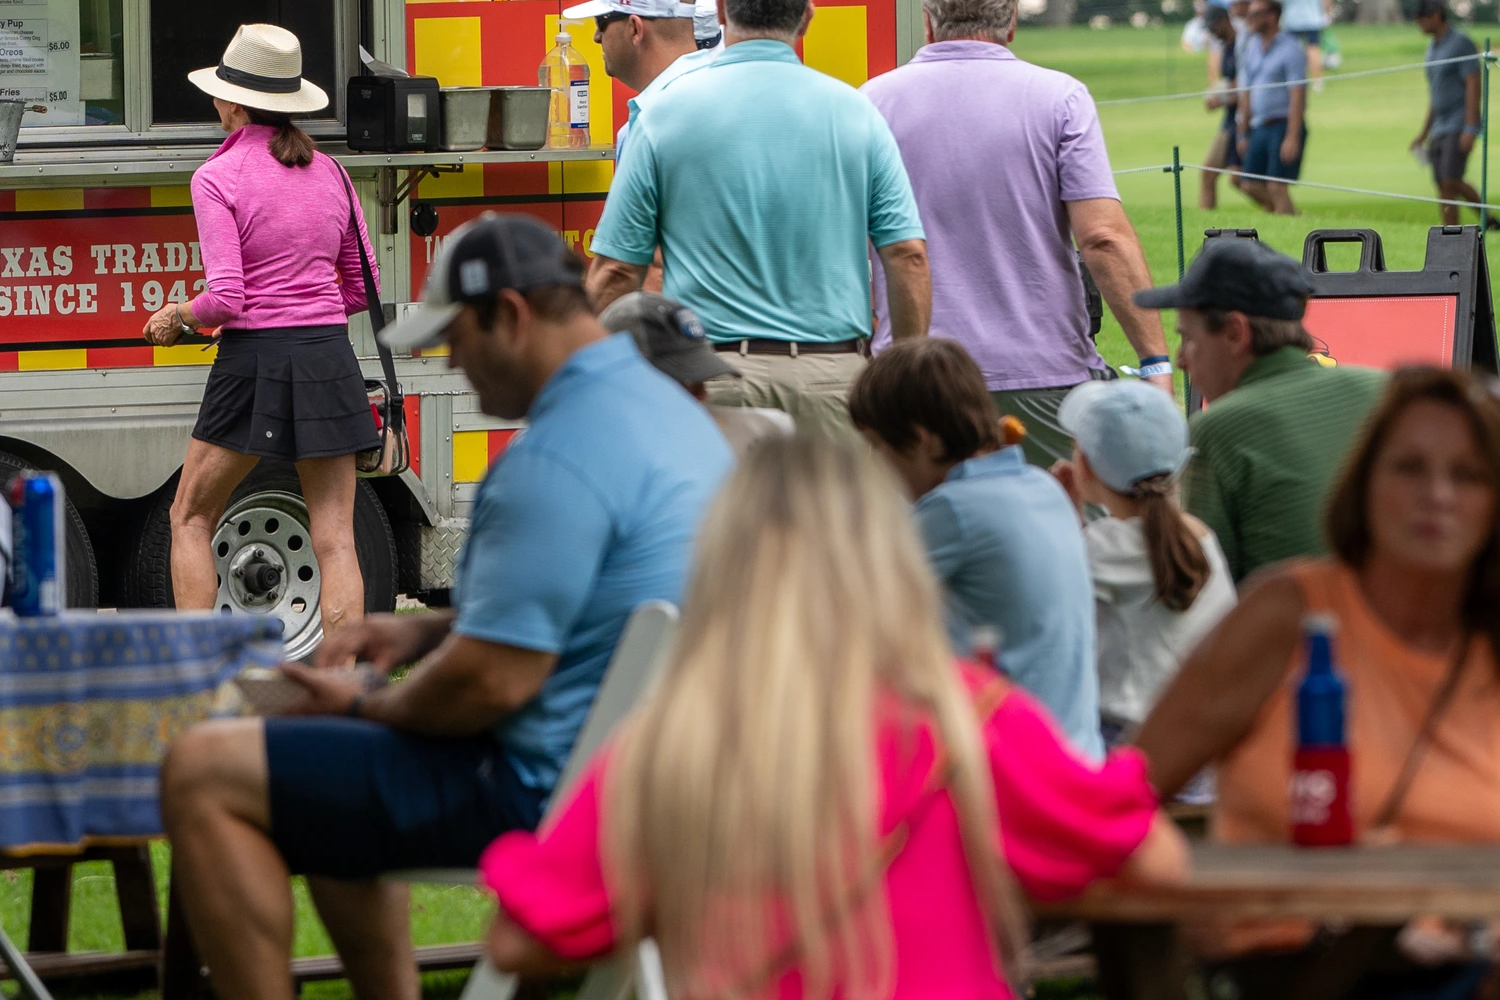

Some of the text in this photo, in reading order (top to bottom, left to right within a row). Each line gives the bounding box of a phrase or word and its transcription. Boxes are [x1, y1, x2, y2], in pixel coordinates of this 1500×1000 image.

[8, 20, 24, 29] Pup
[49, 41, 70, 51] $6.00
[0, 48, 23, 56] Oreos
[0, 88, 20, 96] Fries
[49, 91, 67, 102] $5.00
[91, 241, 203, 275] TRADI
